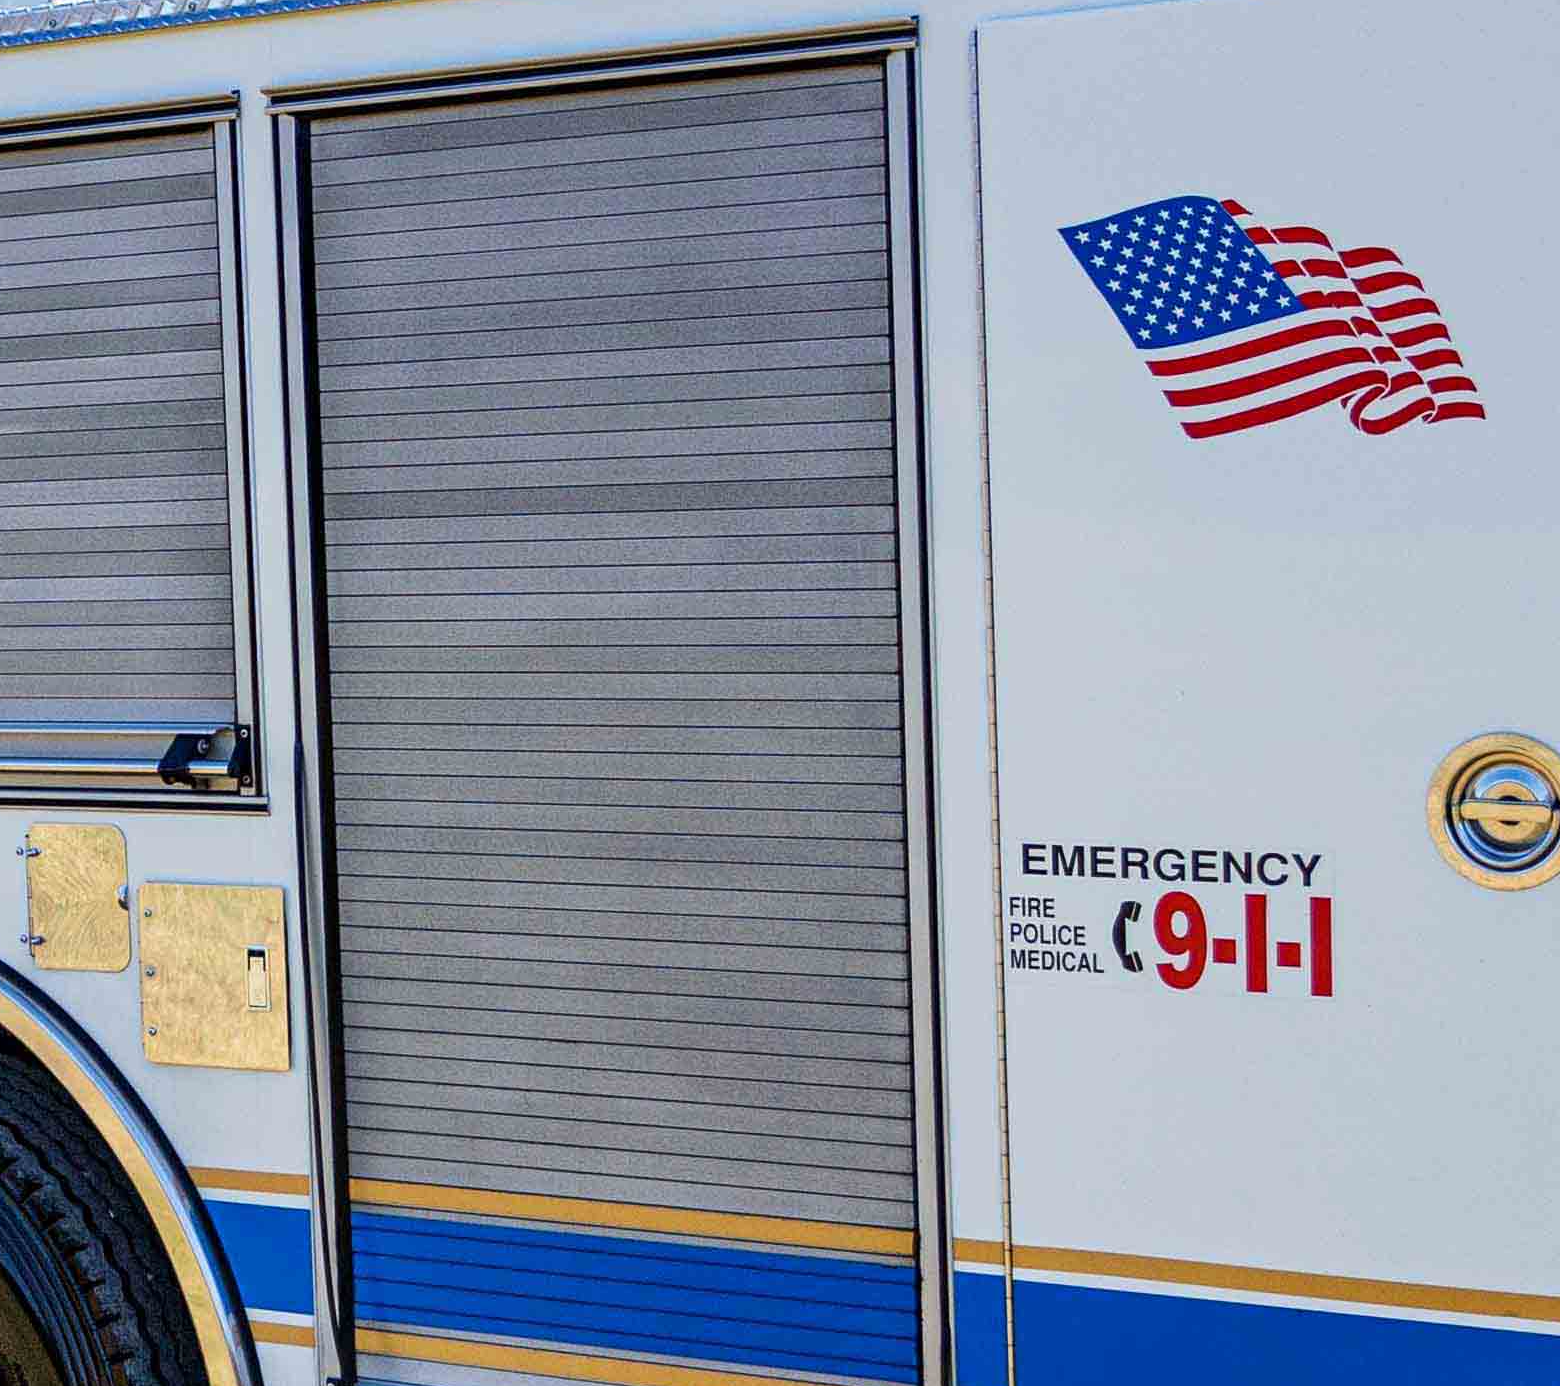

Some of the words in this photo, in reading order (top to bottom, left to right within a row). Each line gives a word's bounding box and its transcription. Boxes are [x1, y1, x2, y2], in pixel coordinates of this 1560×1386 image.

[1022, 843, 1322, 887] EMERGENCY
[1009, 896, 1055, 918] FIRE
[1010, 923, 1087, 947] POLICE
[1010, 950, 1105, 974] MEDICAL
